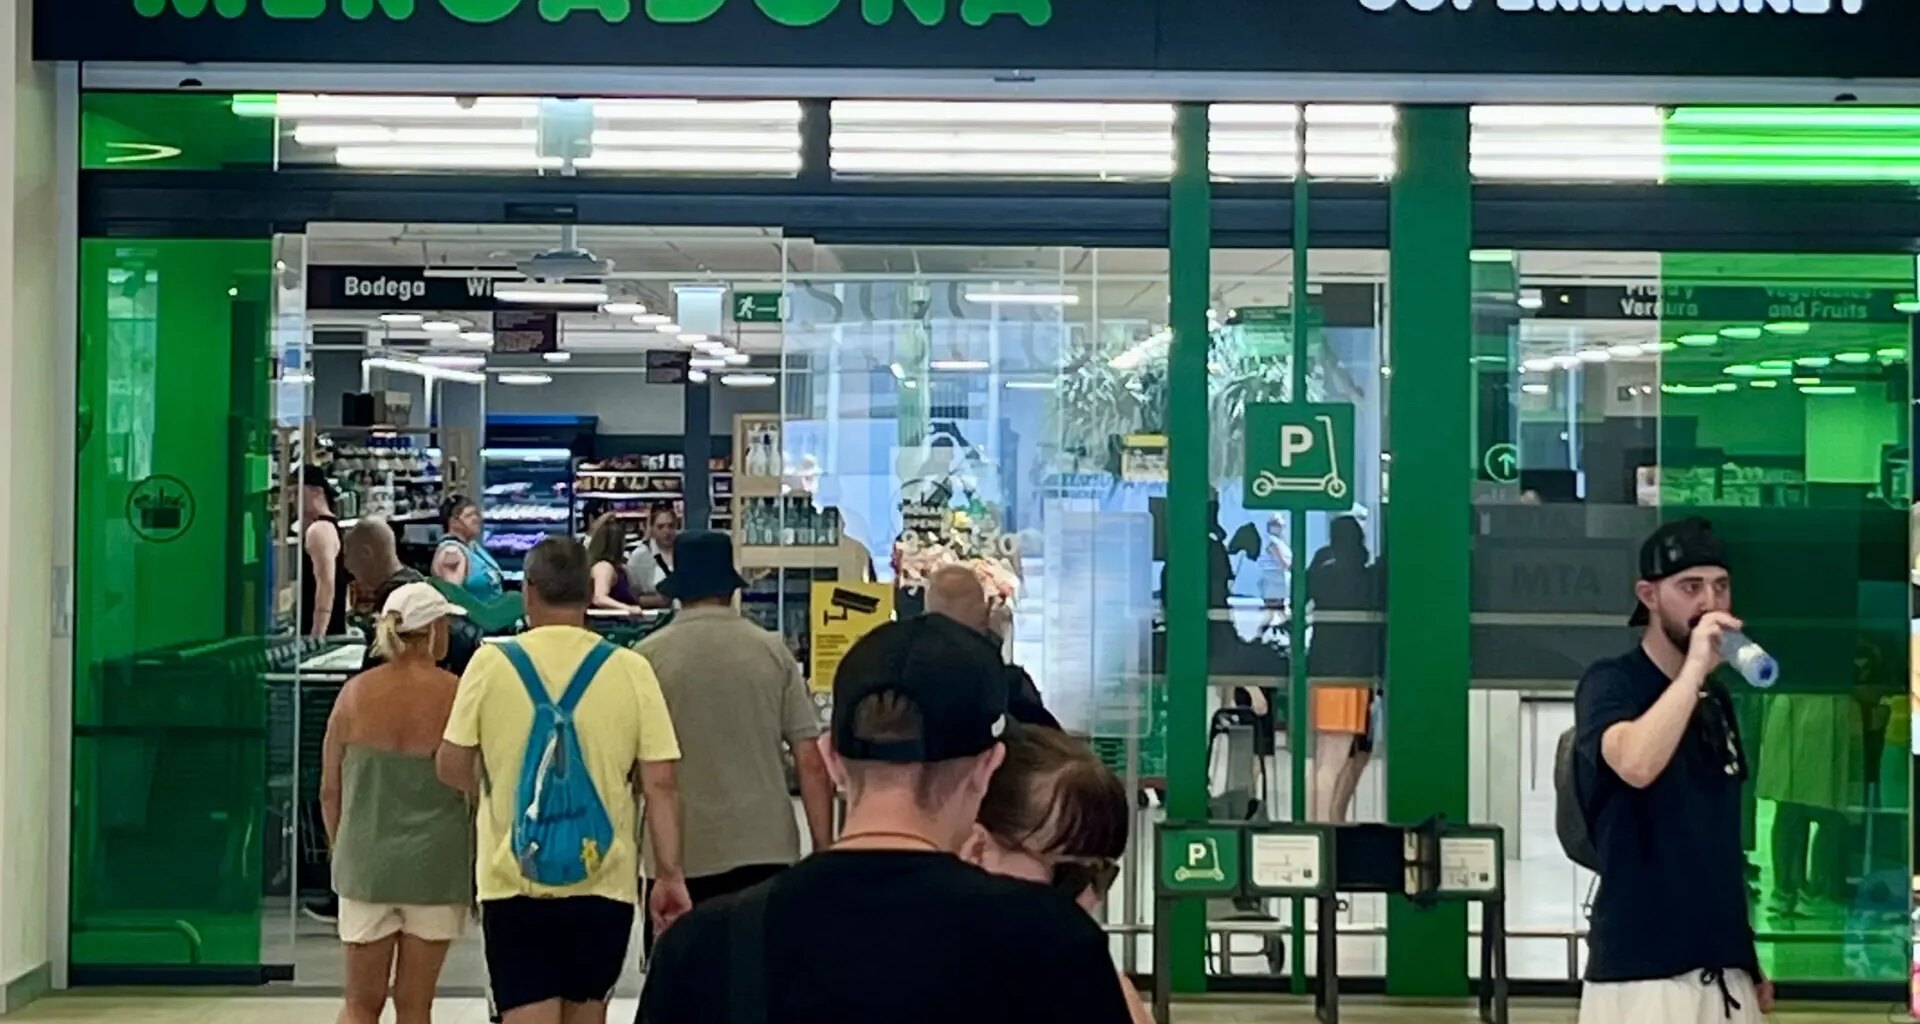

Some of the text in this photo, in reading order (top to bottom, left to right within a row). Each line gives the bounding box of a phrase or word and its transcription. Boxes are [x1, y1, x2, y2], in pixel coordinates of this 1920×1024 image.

[344, 276, 426, 301] Bodega
[1768, 301, 1868, 319] and Fruits
[1281, 425, 1314, 467] P
[1188, 842, 1207, 867] P
